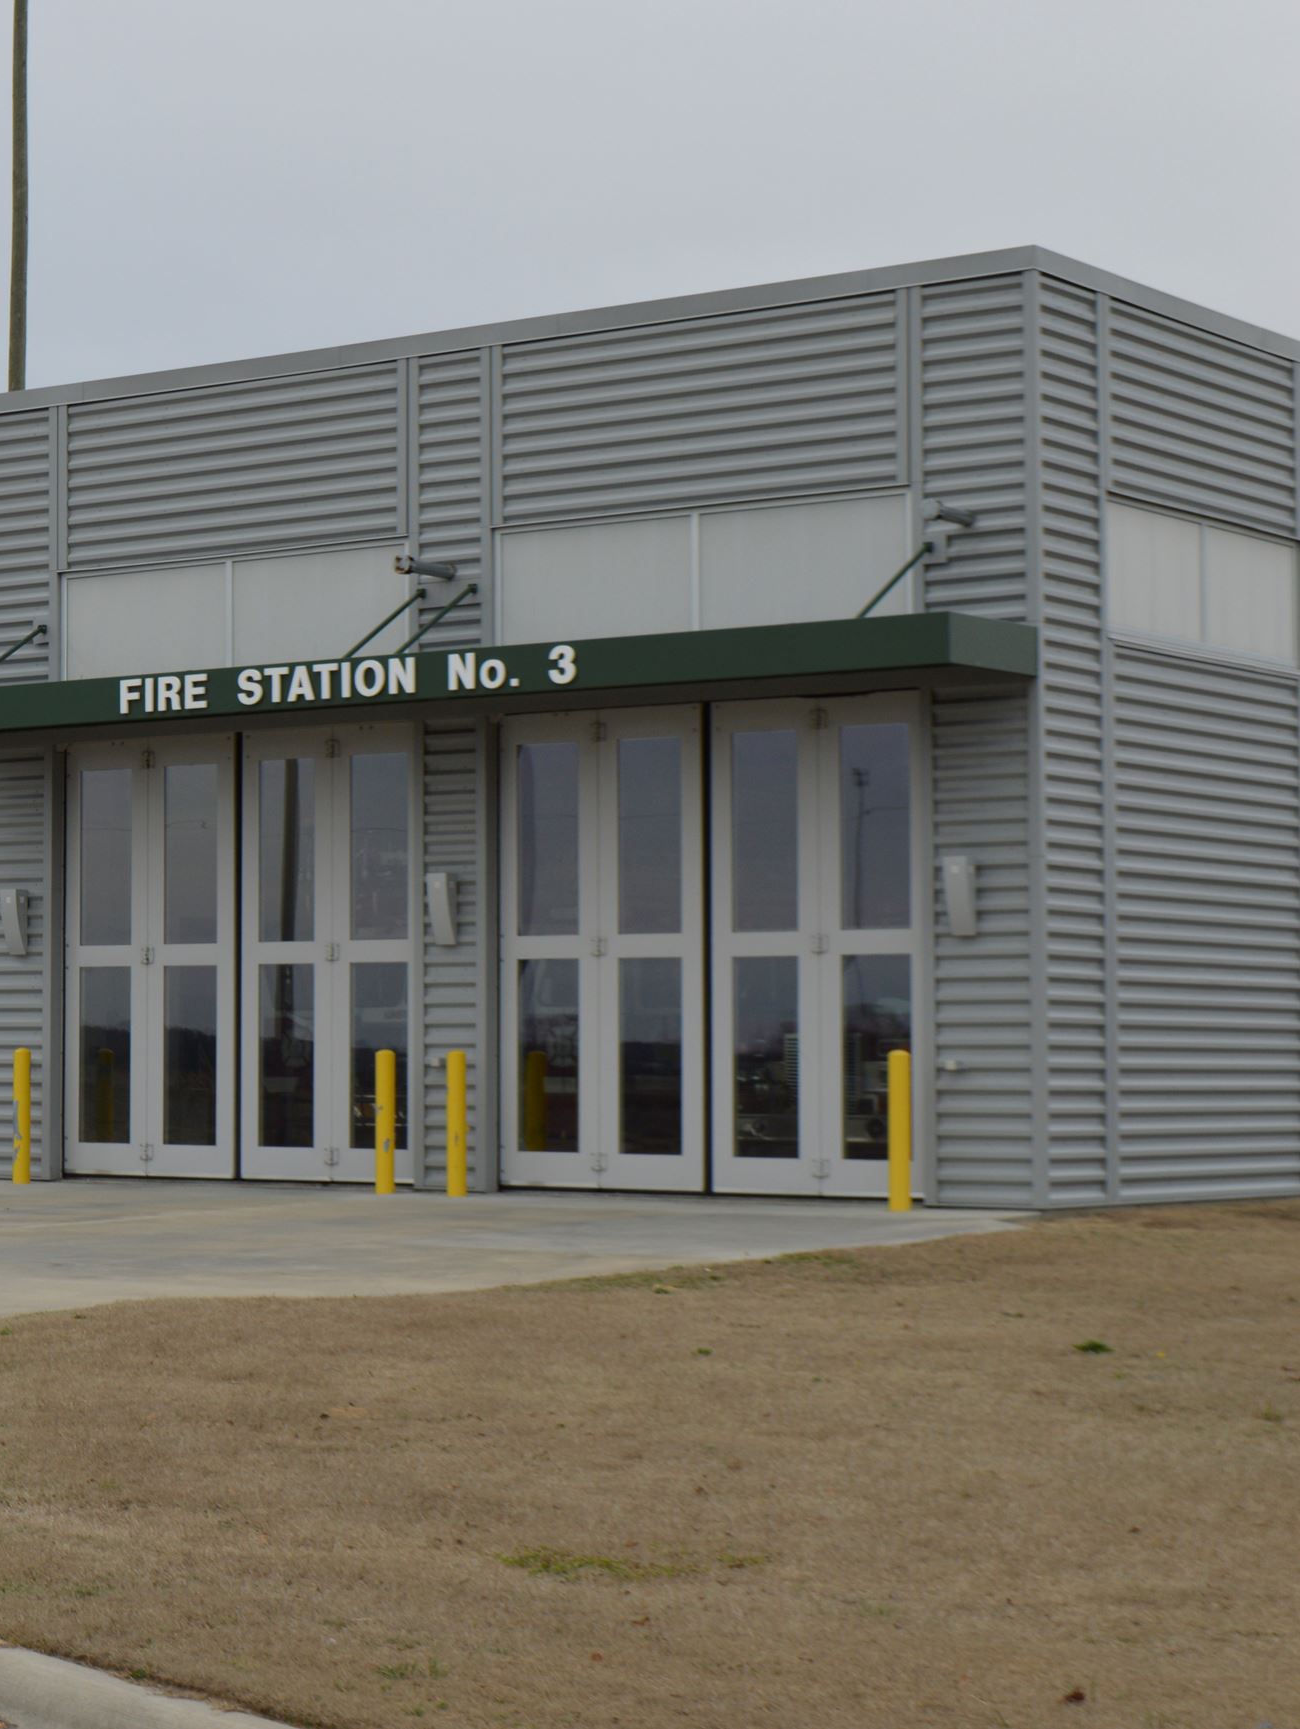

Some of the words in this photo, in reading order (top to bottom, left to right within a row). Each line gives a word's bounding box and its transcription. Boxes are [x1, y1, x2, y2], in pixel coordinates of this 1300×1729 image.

[119, 673, 208, 715] FIRE
[237, 656, 416, 706] STATION
[447, 652, 520, 691] No.
[548, 644, 577, 685] 3
